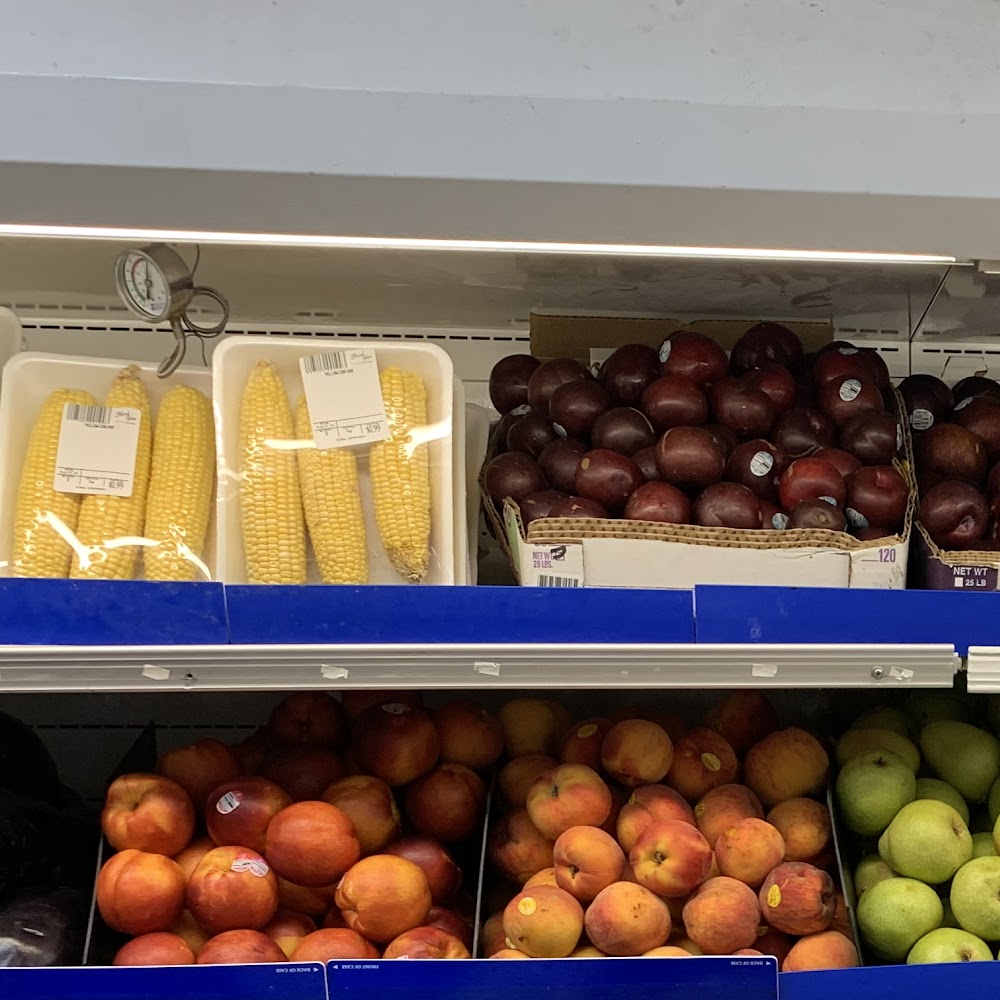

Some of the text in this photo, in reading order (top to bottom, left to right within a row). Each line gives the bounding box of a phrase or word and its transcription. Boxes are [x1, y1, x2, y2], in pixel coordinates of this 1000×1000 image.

[532, 551, 543, 560] NET
[879, 548, 896, 563] 120
[953, 567, 989, 576] NET WT
[965, 579, 987, 587] 25 LB
